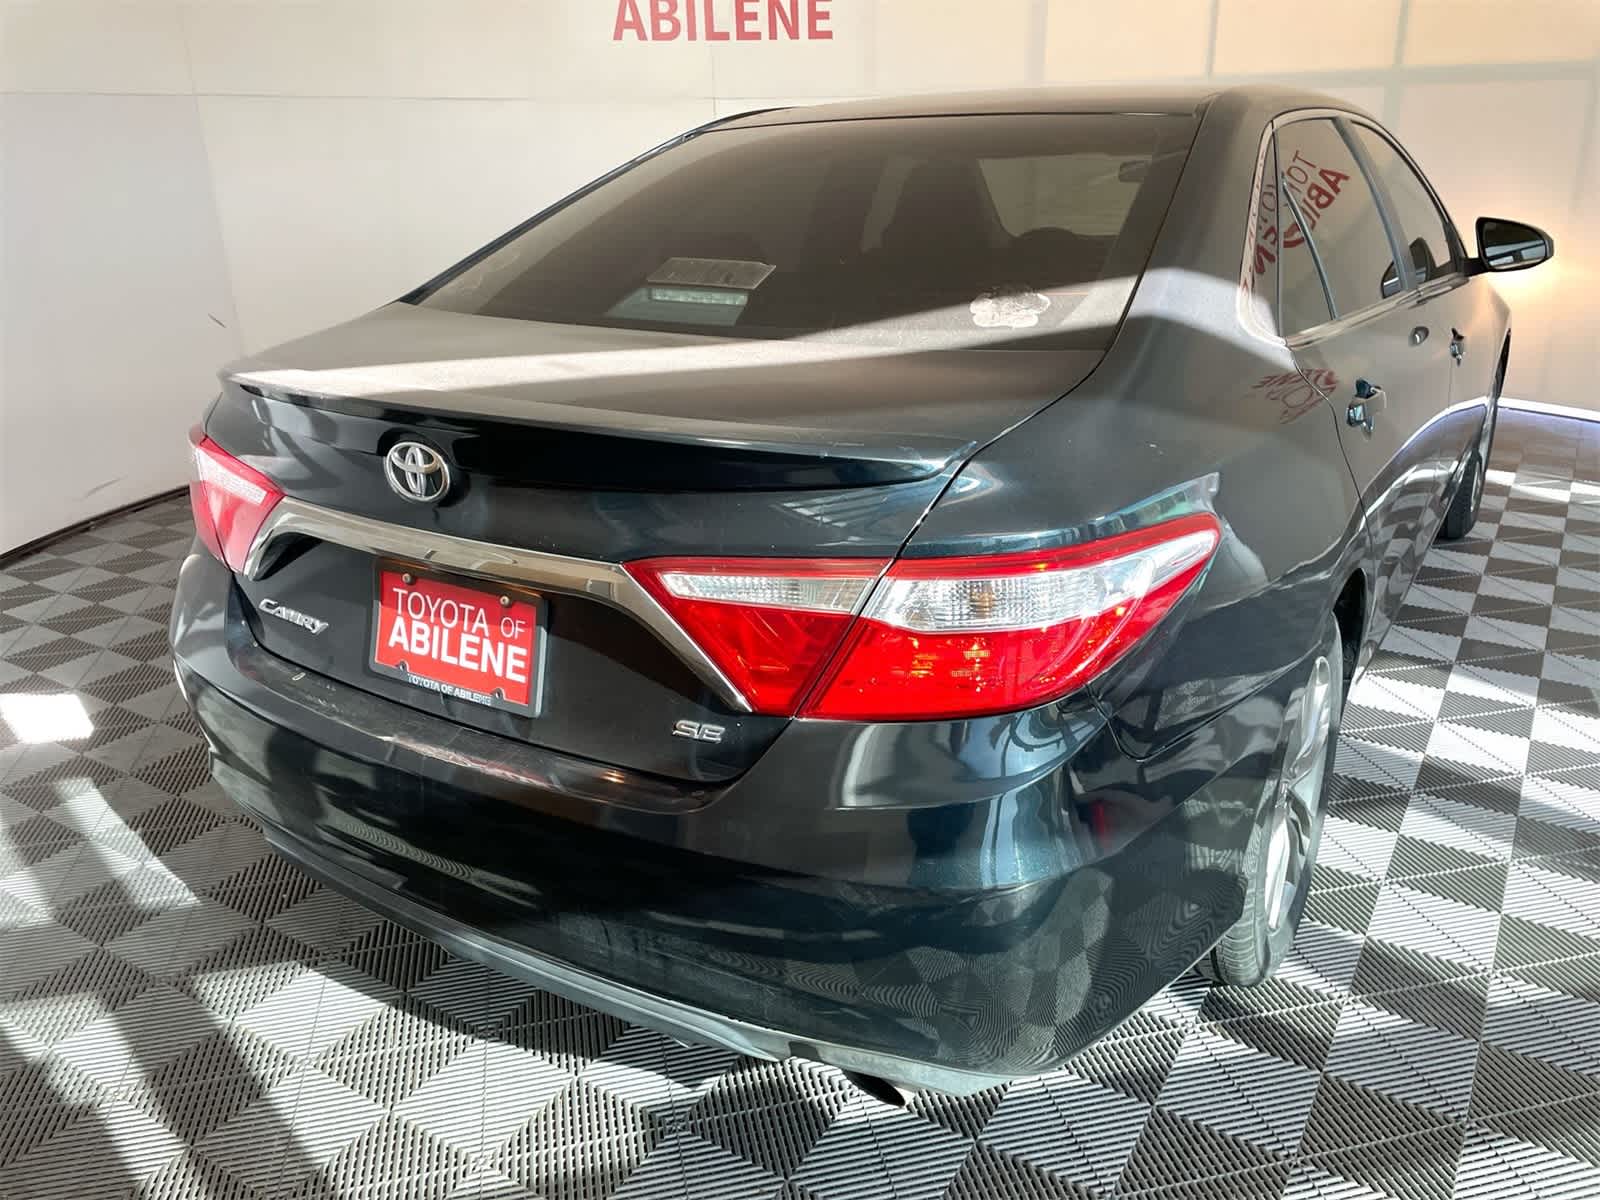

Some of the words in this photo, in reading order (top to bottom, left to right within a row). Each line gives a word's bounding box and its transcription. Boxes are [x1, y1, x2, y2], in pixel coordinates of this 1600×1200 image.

[612, 0, 834, 41] ABILENE
[393, 587, 489, 637] TOYOTA
[500, 616, 526, 639] OF
[388, 615, 528, 684] ABILENE
[408, 673, 440, 692] TOYOTA
[441, 684, 454, 695] OF
[454, 687, 492, 706] ABILENE
[672, 720, 725, 742] SE
